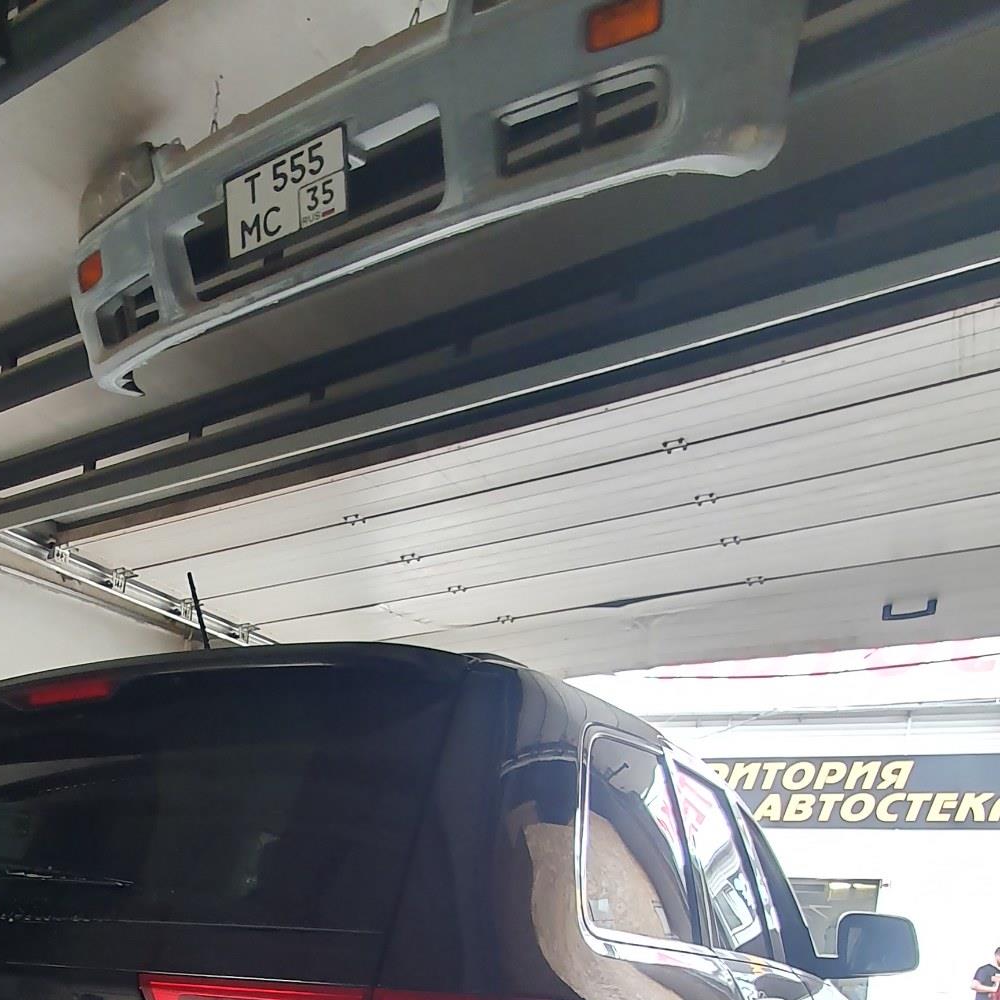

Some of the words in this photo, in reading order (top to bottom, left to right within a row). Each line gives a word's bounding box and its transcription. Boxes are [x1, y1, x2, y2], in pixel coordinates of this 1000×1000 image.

[306, 178, 335, 211] 35
[241, 206, 282, 249] МС
[303, 211, 321, 225] RUS
